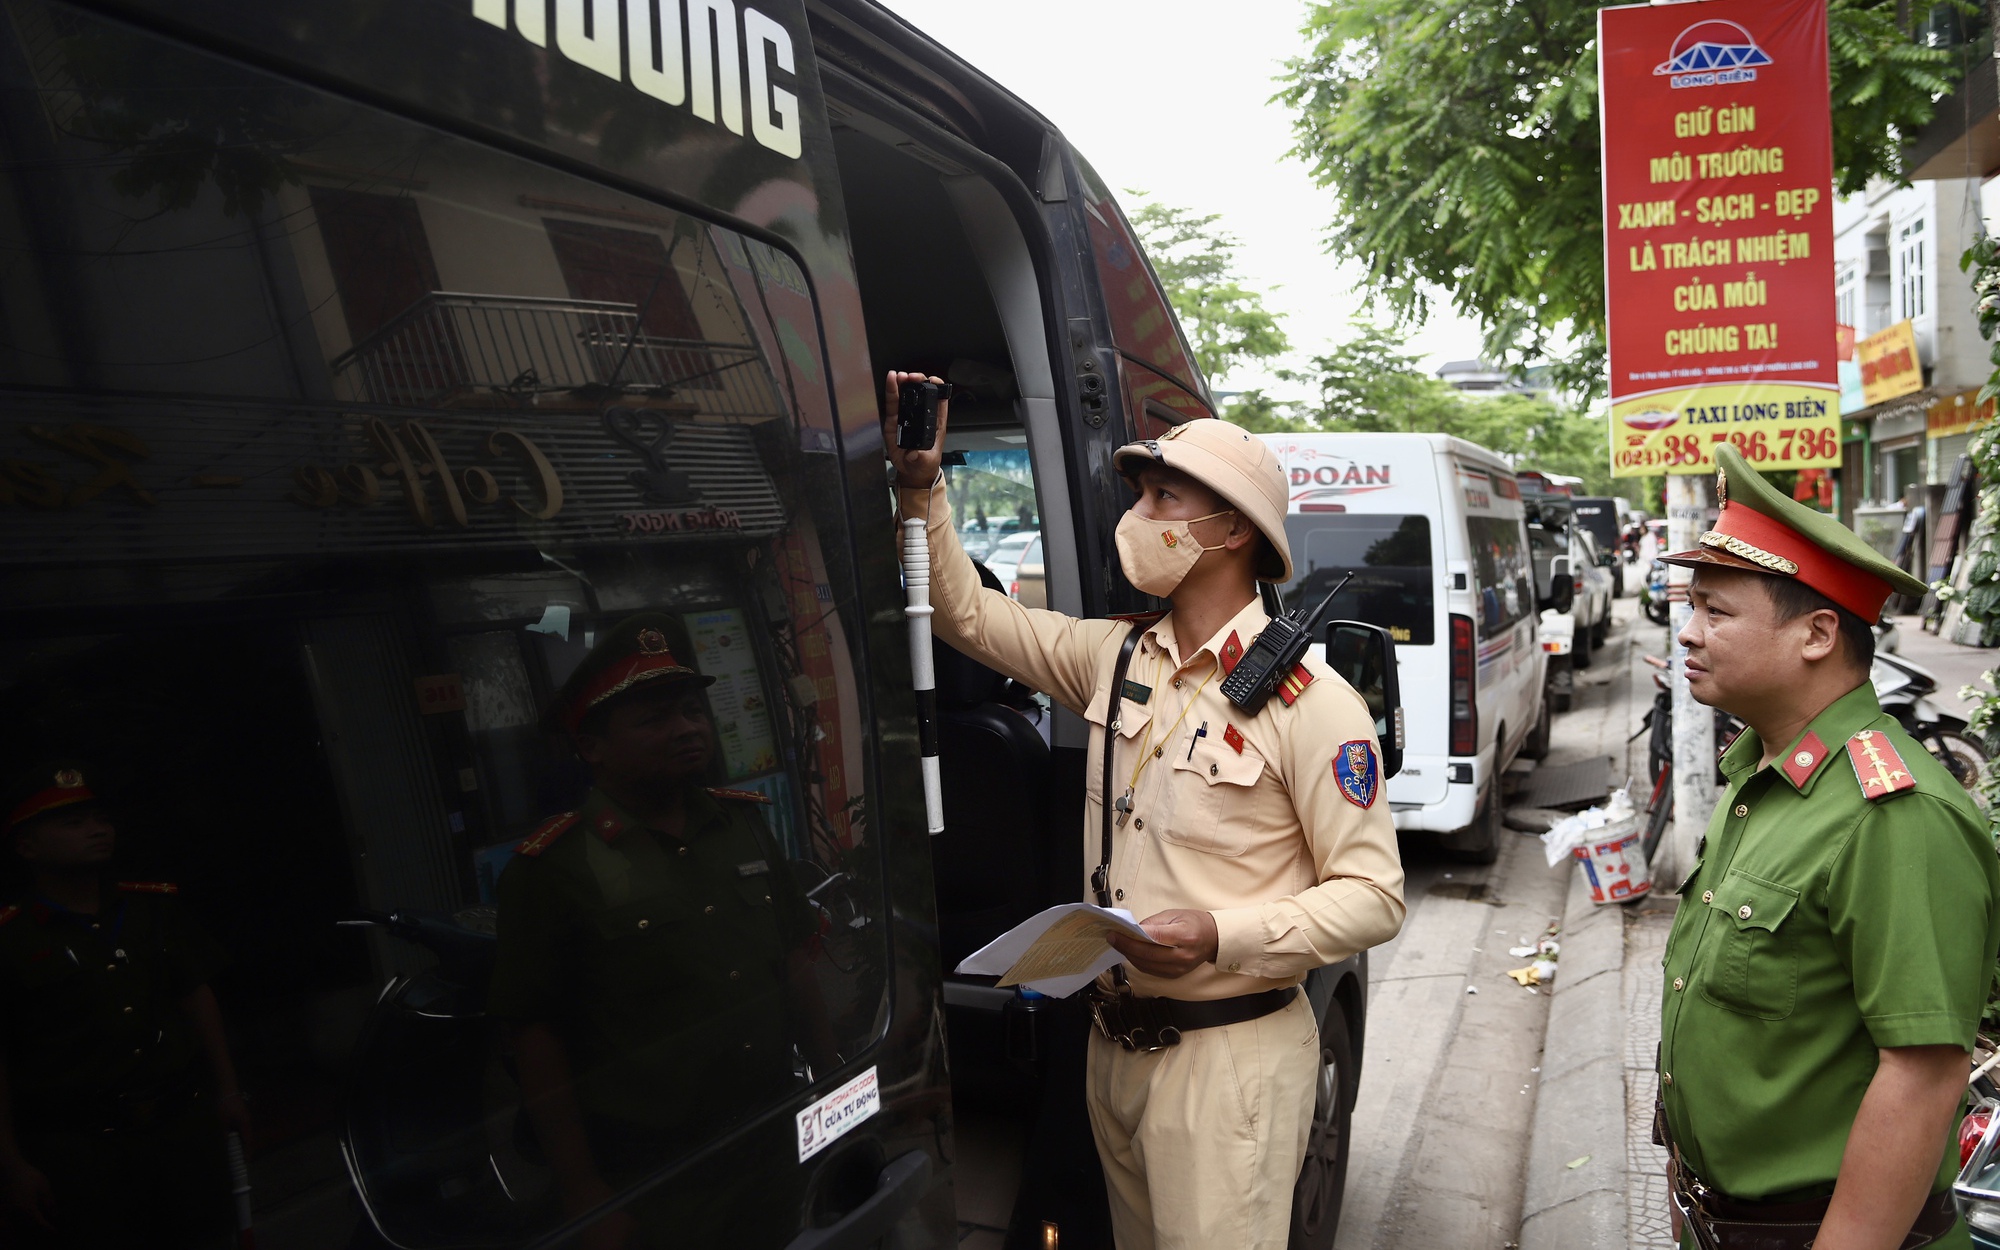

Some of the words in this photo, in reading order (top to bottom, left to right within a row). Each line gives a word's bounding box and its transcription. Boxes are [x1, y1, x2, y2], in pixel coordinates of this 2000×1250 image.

[1671, 74, 1714, 88] LONG
[1717, 69, 1757, 85] BIÊN
[1674, 105, 1713, 138] GIỮ
[1717, 102, 1756, 135] GÌN
[1650, 151, 1692, 184] MÔI
[1697, 144, 1784, 178] TRƯỜNG
[1618, 200, 1676, 229] XANH
[1696, 193, 1755, 227] SẠCH
[1776, 188, 1820, 220] ĐẸP
[1629, 240, 1657, 272] LÀ
[1661, 237, 1732, 269] TRÁCH
[1737, 229, 1810, 266] NHIỆM
[1674, 276, 1719, 312] CỦA
[1723, 271, 1767, 308] MỖI
[1665, 323, 1739, 356] CHÚNG
[1744, 323, 1778, 350] TA!
[1685, 405, 1727, 425] TAXI
[1733, 402, 1779, 422] LONG
[1785, 396, 1827, 420] BIÊN
[1290, 461, 1390, 486] ĐOÀN
[825, 1110, 842, 1128] CỬA
